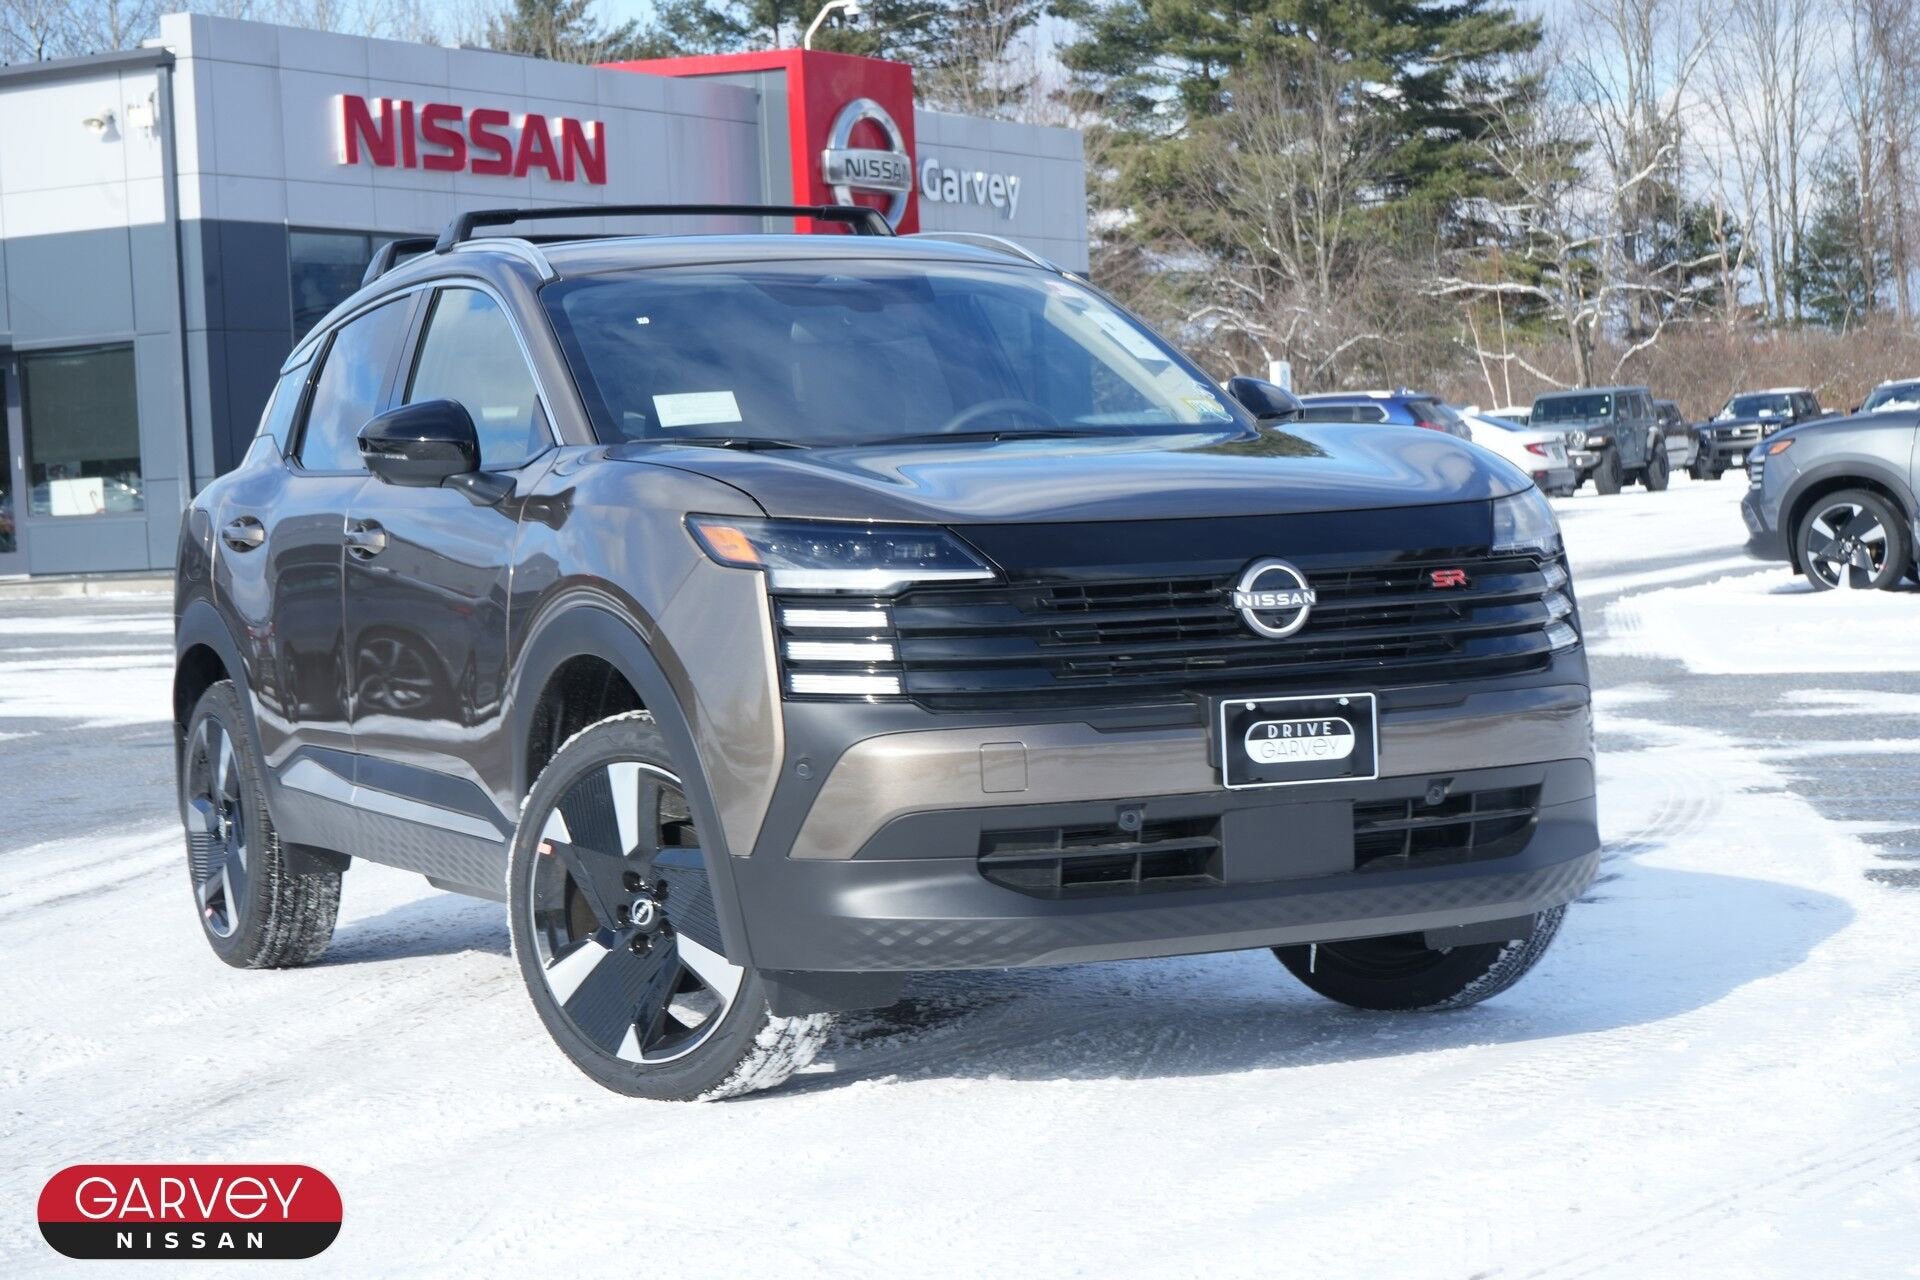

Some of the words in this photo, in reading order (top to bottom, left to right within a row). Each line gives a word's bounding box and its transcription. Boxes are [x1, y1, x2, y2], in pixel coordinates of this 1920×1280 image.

[335, 94, 607, 185] NISSAN
[920, 157, 1021, 220] Garvey
[1431, 568, 1467, 588] SR
[1236, 591, 1316, 608] NISSAN
[1267, 721, 1332, 739] DRIVE
